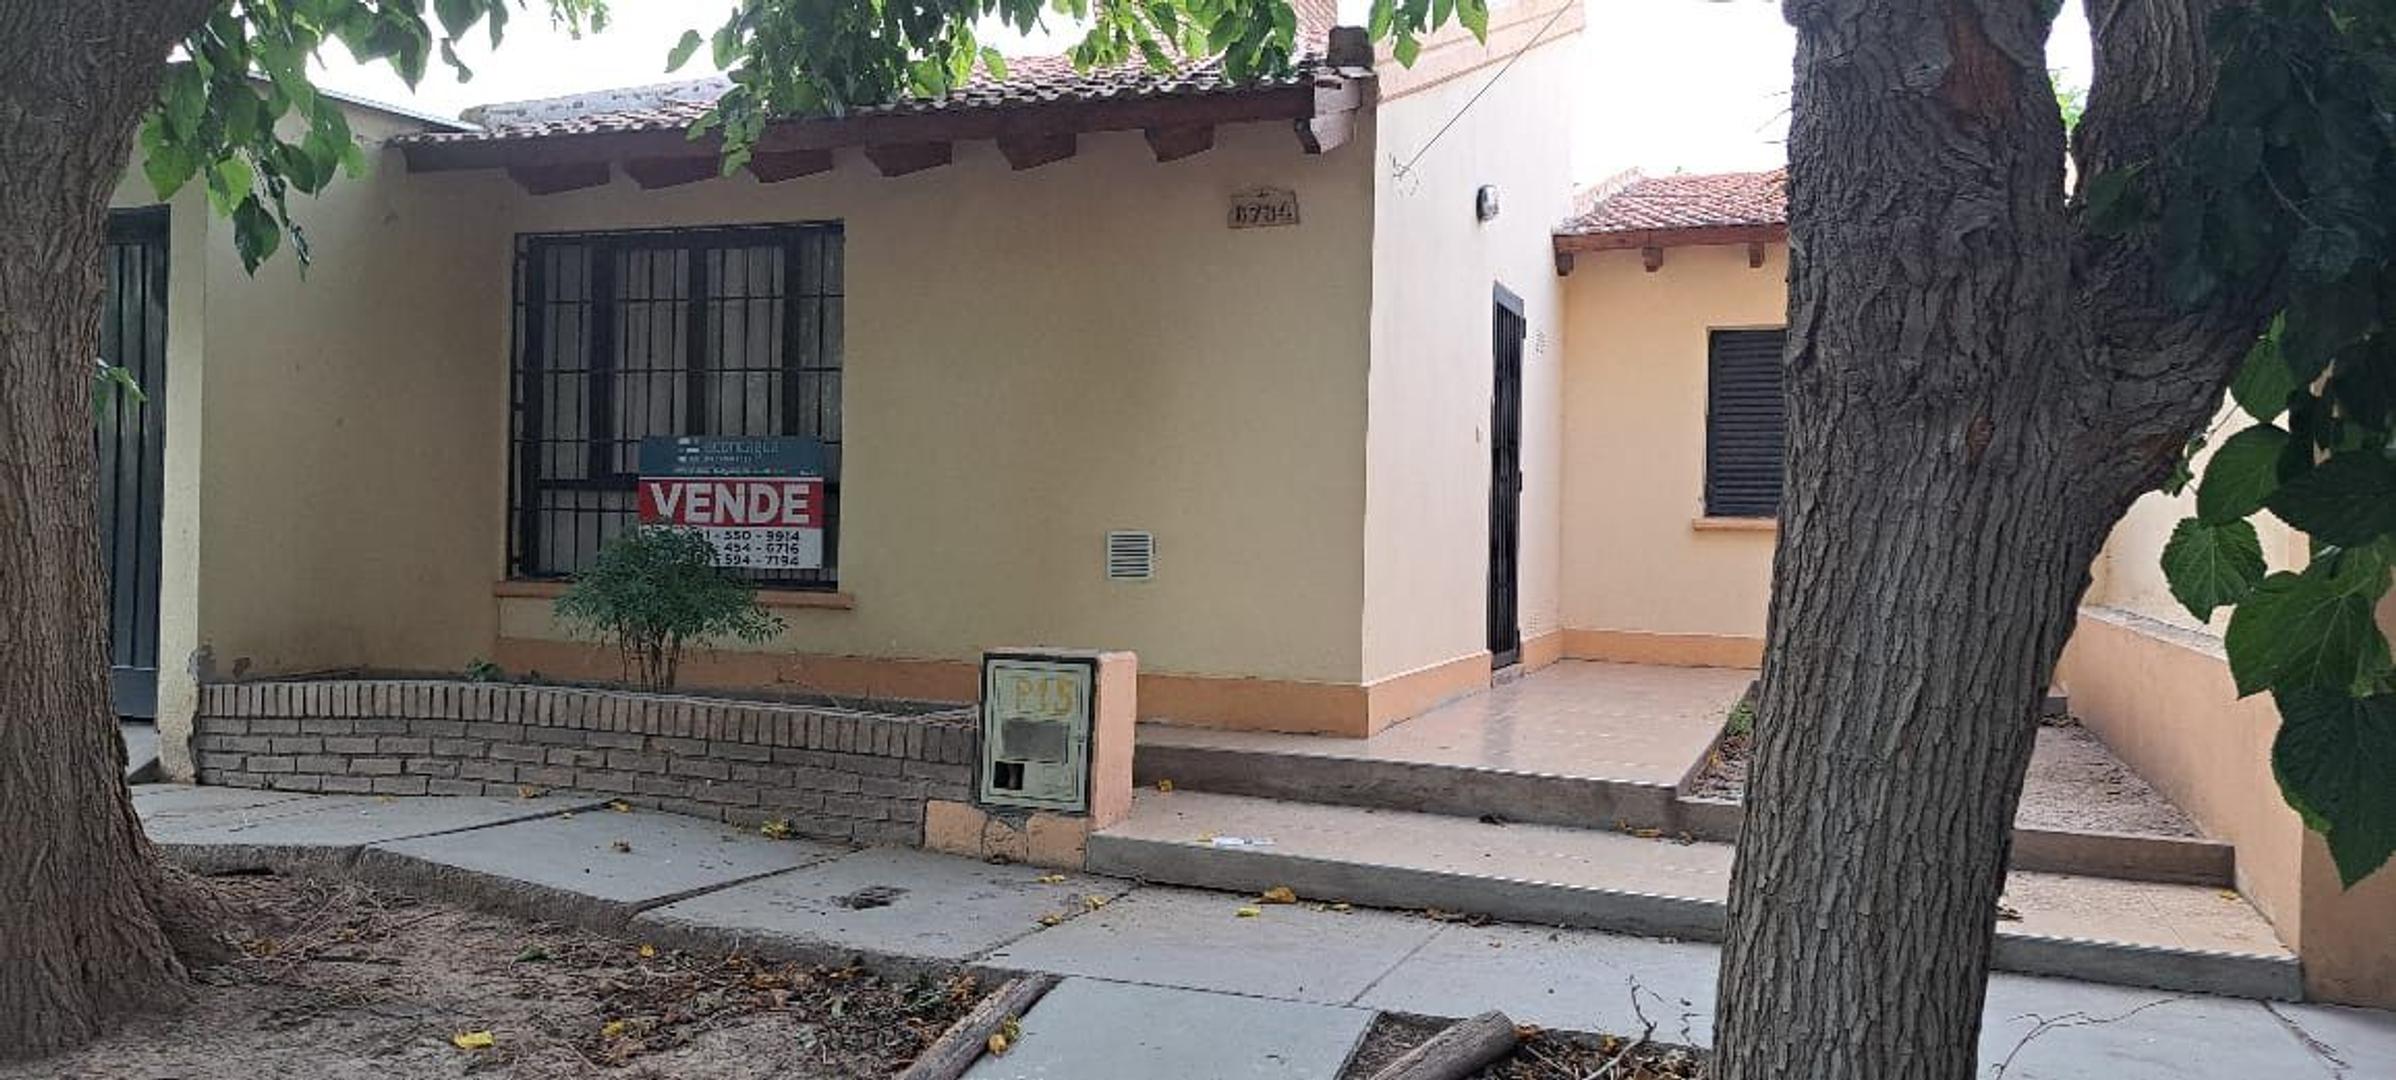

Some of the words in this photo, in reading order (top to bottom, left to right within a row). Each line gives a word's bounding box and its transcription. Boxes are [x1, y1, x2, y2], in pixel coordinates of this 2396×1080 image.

[650, 482, 811, 525] VENDE
[723, 530, 752, 541] 550
[723, 542, 751, 553] 454
[724, 554, 751, 566] 594
